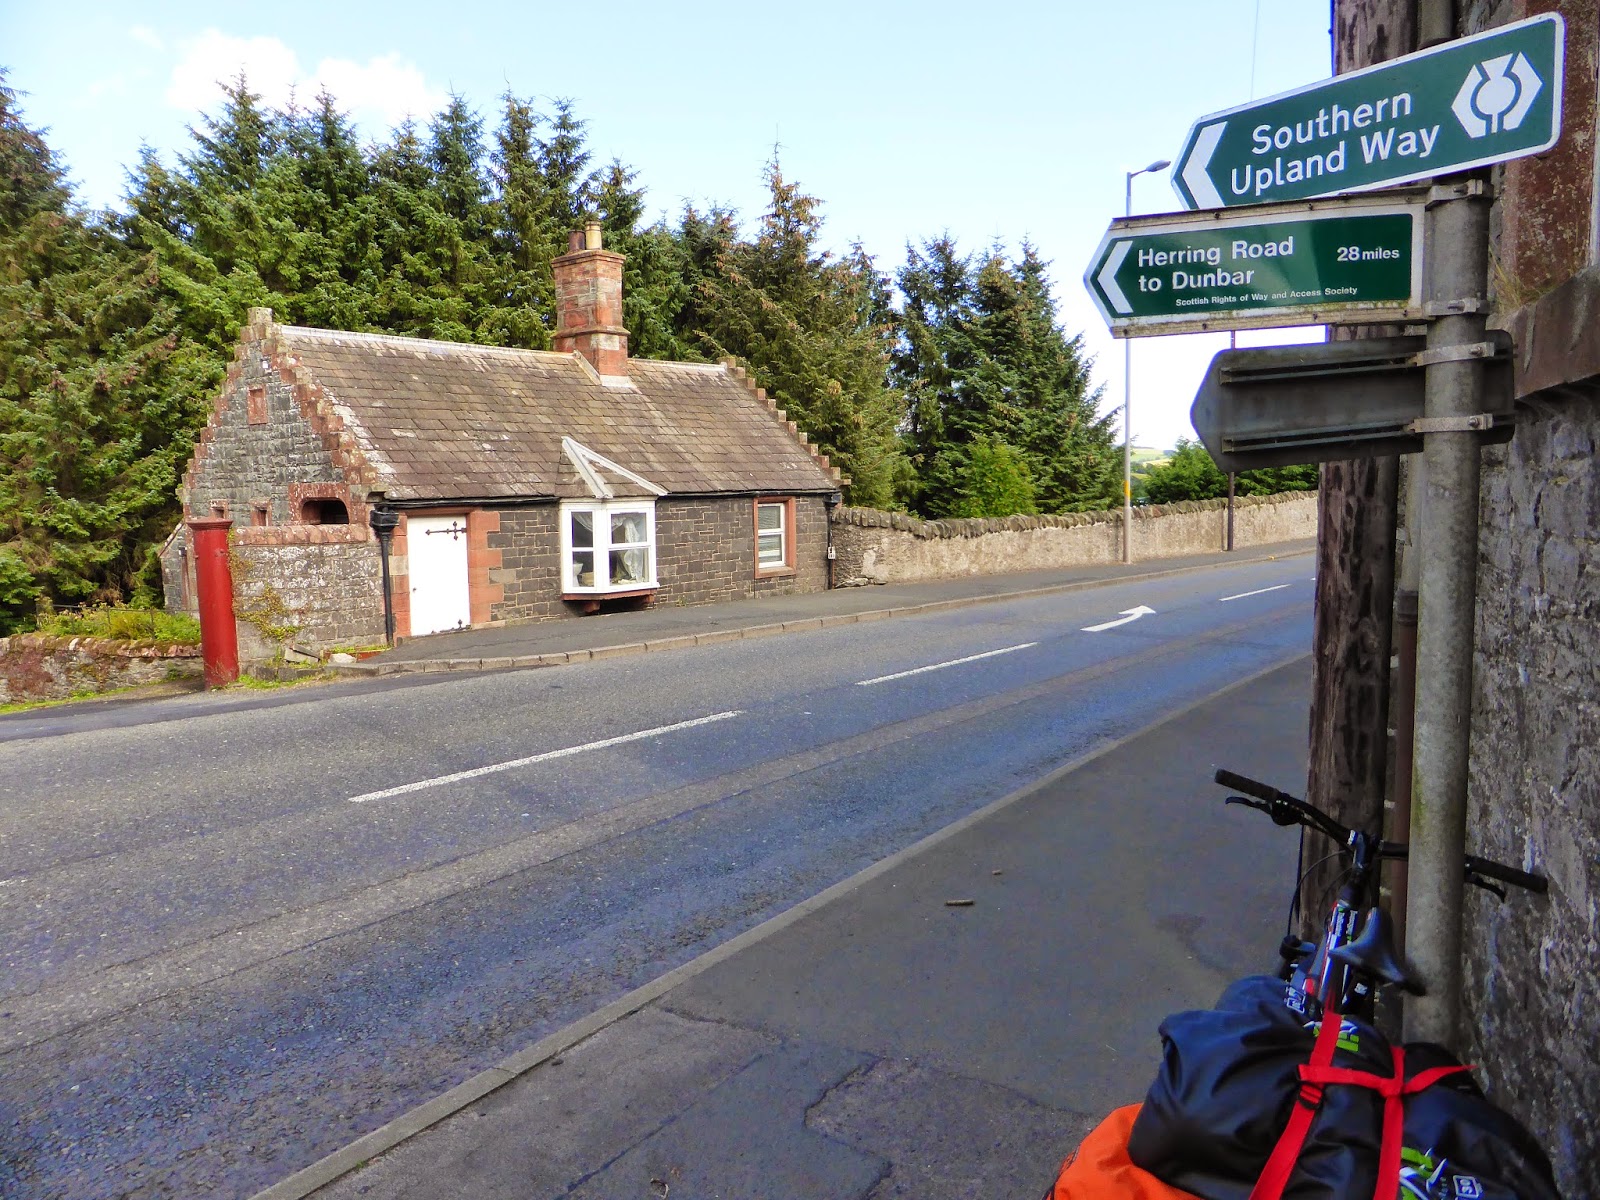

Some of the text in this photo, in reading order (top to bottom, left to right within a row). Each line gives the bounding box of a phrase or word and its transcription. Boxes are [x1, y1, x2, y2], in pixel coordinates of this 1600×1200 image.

[1251, 92, 1412, 155] Southern
[1231, 124, 1440, 196] Upland Way
[1138, 236, 1294, 268] Herring Road
[1336, 246, 1400, 262] 28 miles
[1138, 268, 1255, 292] to Dunbar
[1175, 286, 1358, 307] Scottish Rights of Way and Access Society
